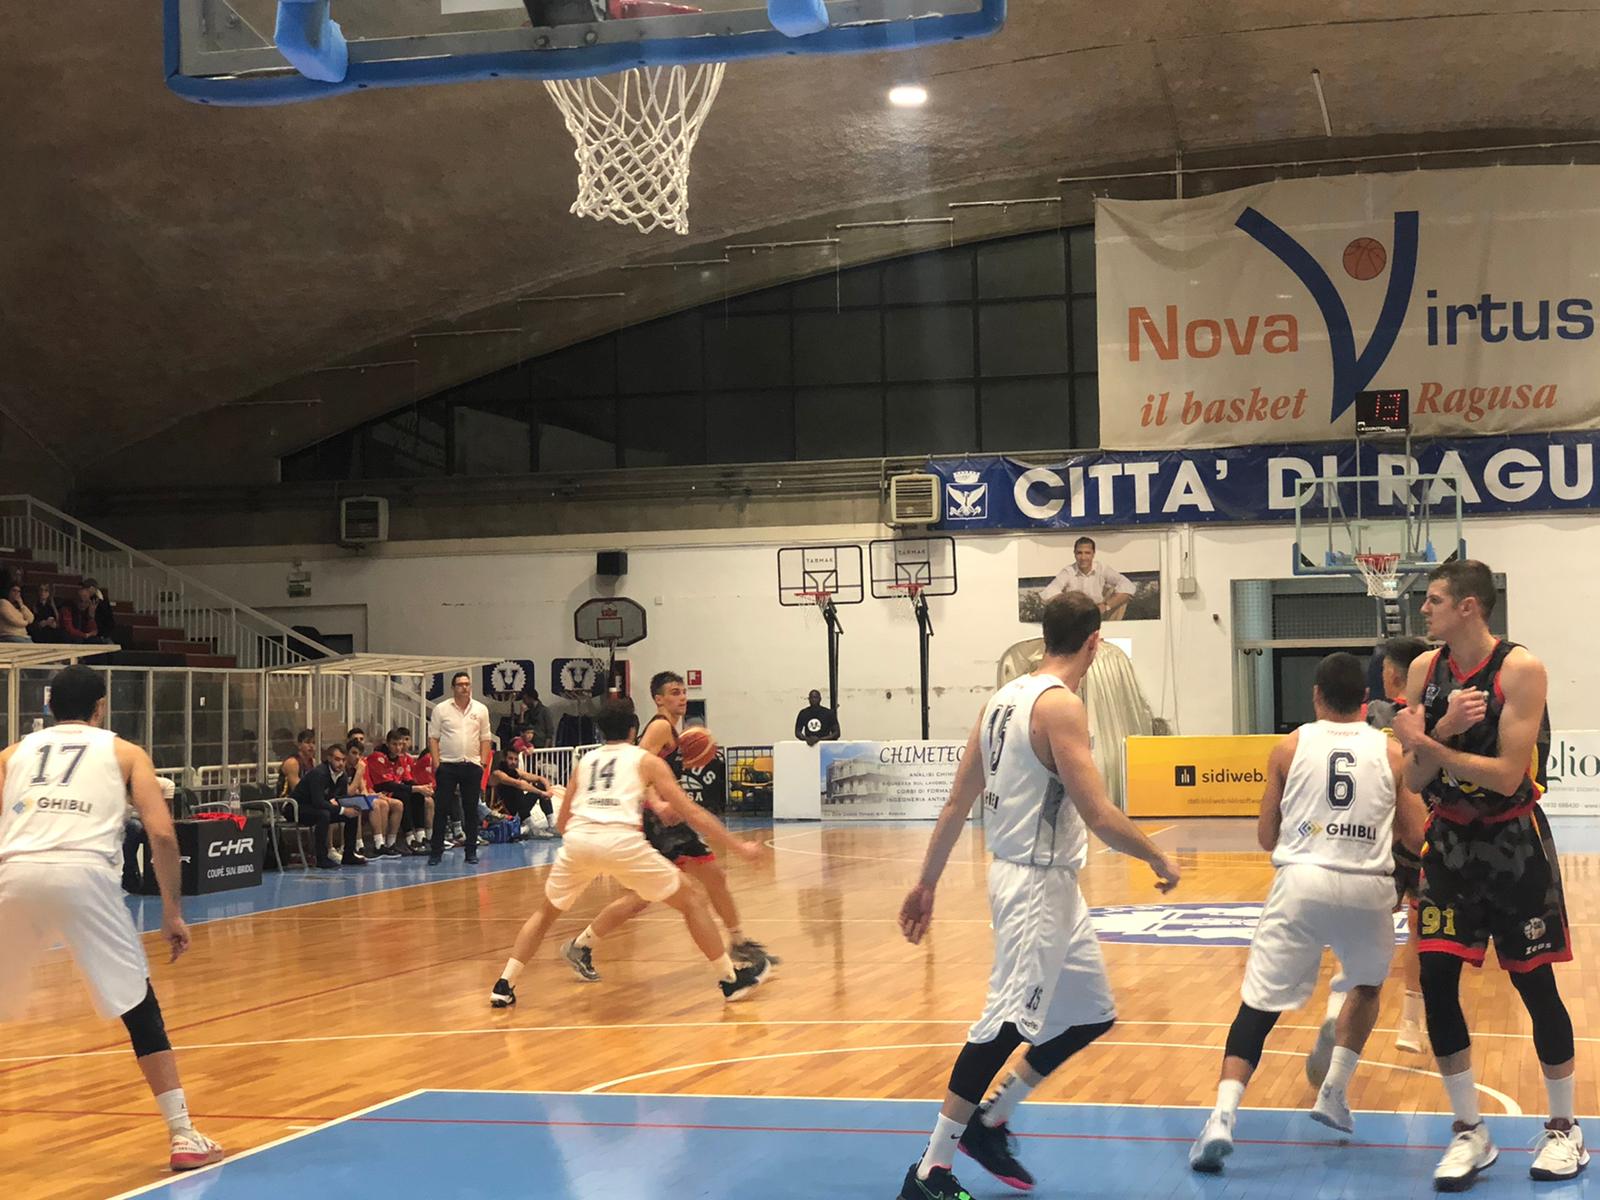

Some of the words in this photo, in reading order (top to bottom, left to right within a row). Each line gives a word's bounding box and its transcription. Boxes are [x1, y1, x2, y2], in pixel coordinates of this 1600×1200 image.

[1128, 304, 1299, 362] Nova
[1141, 391, 1170, 427] il
[1181, 386, 1309, 426] basket
[1413, 382, 1558, 423] Ragusa
[1013, 459, 1229, 519] CITTA'
[1268, 454, 1338, 510] DI
[1378, 443, 1594, 506] RAGU
[30, 742, 90, 787] 17
[587, 756, 618, 792] 14
[1202, 768, 1268, 783] sidiweb.
[1326, 748, 1357, 811] 6
[37, 797, 94, 814] GHIBLI
[208, 838, 254, 858] C-HR
[1326, 823, 1377, 841] GHIBLI
[1422, 906, 1457, 937] 91
